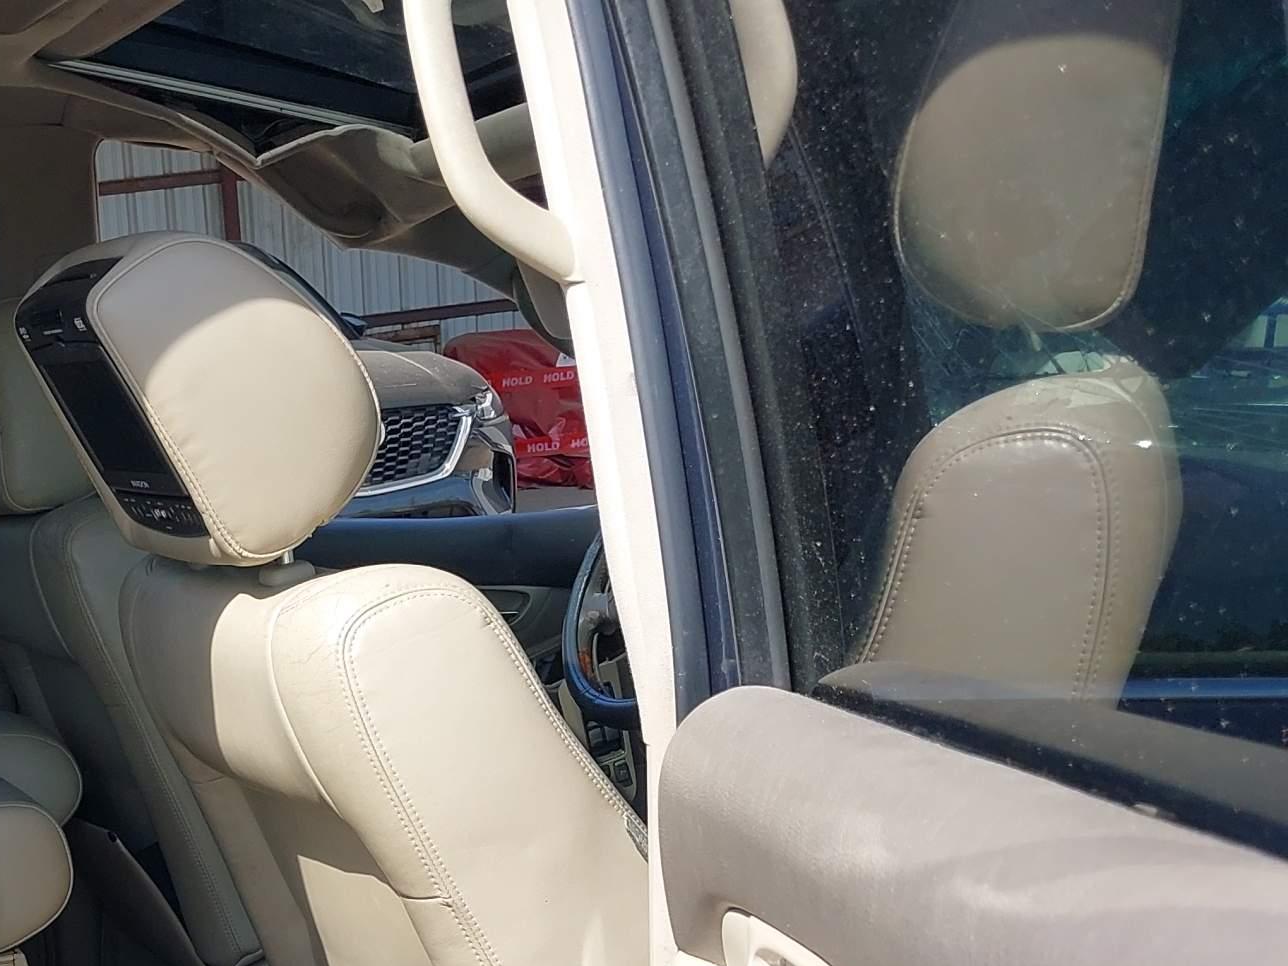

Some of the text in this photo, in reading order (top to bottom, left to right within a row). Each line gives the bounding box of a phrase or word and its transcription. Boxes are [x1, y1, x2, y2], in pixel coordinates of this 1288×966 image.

[502, 376, 533, 387] HOLD
[543, 371, 574, 383] HOLD
[527, 438, 588, 453] HOLD HO
